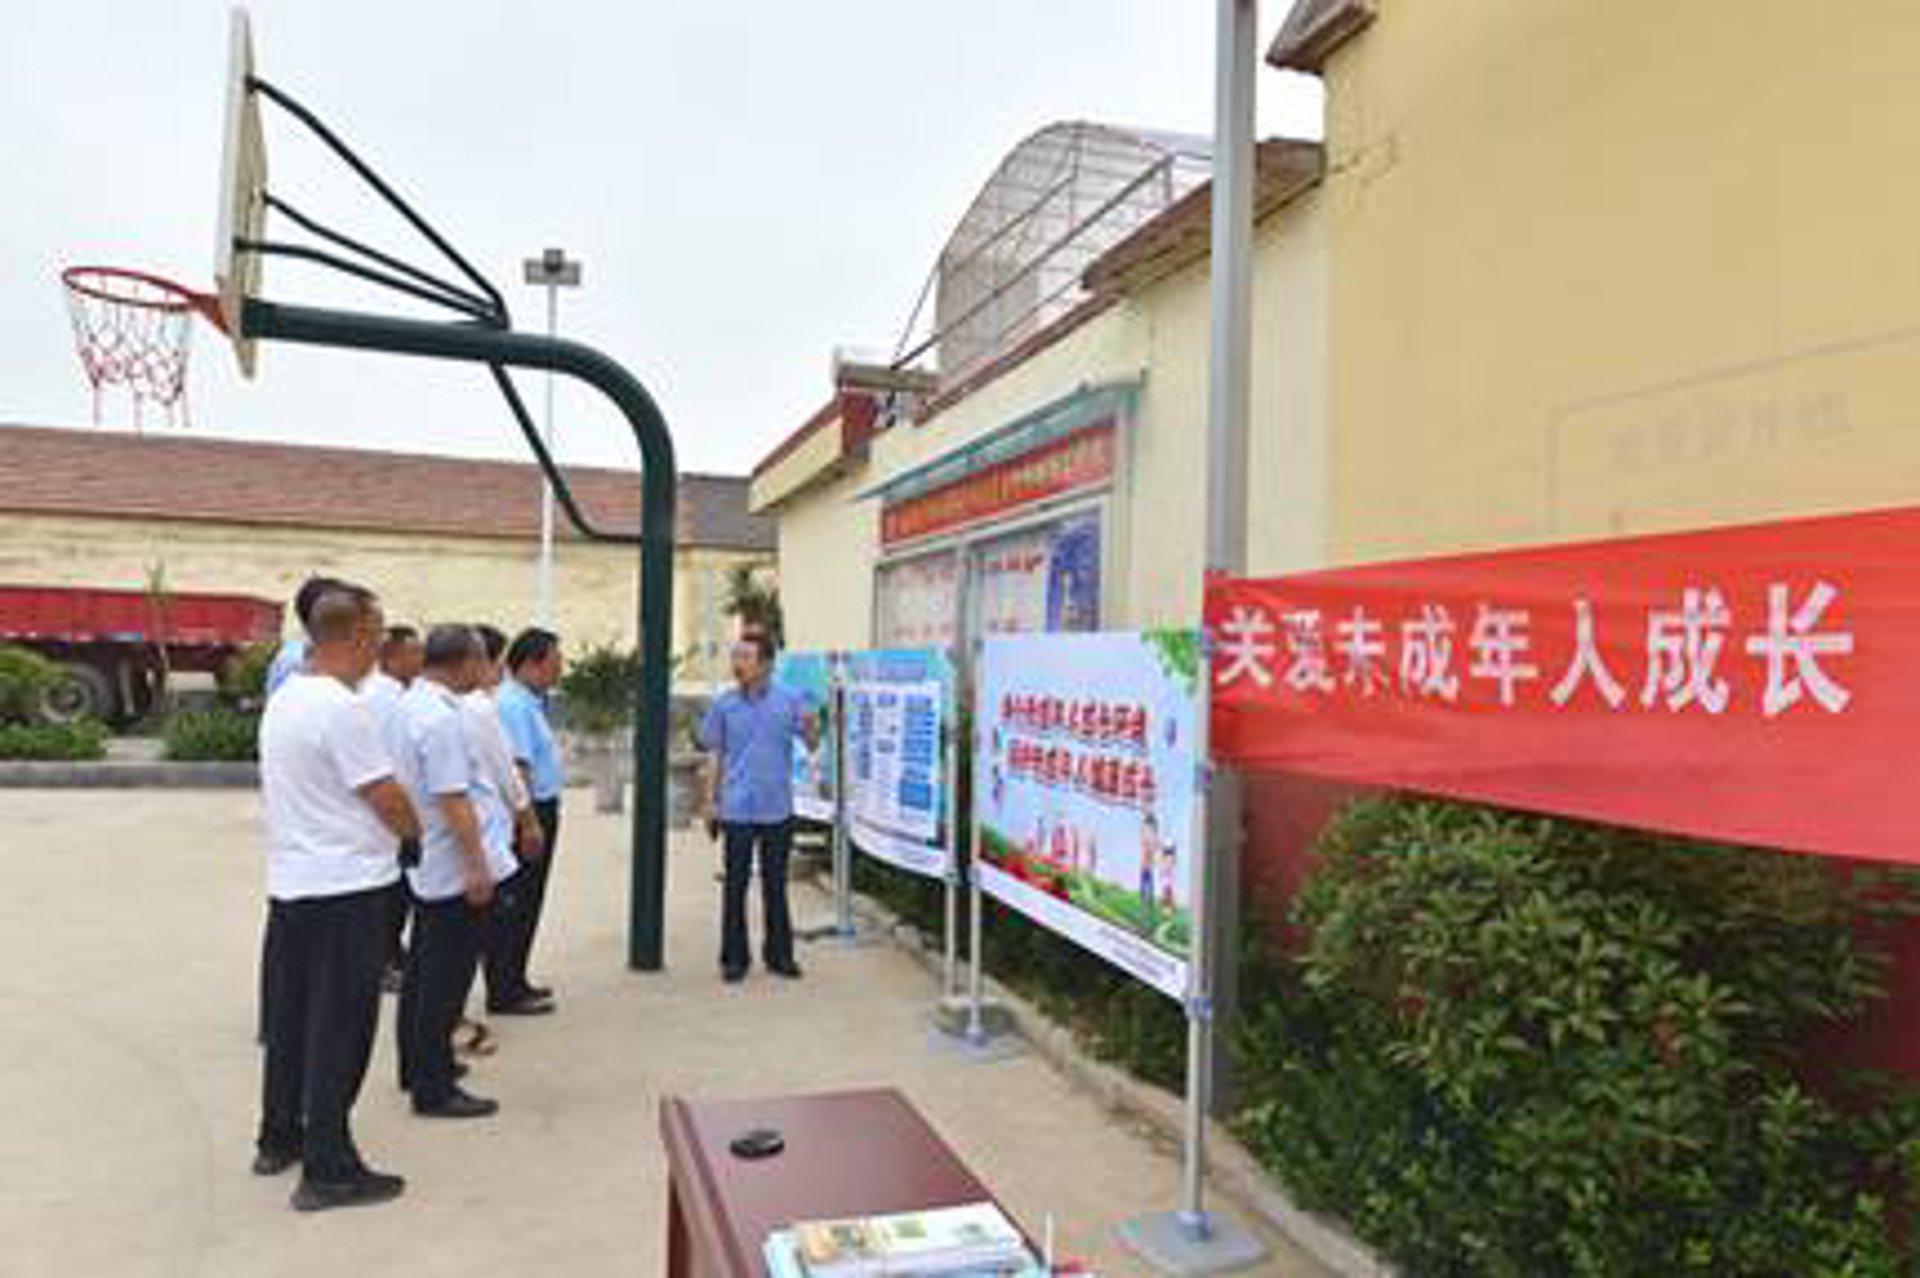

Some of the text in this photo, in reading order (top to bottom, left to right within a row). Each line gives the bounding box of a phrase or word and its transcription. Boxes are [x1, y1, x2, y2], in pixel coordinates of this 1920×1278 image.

[1217, 581, 1854, 717] 关爱未成年人成长
